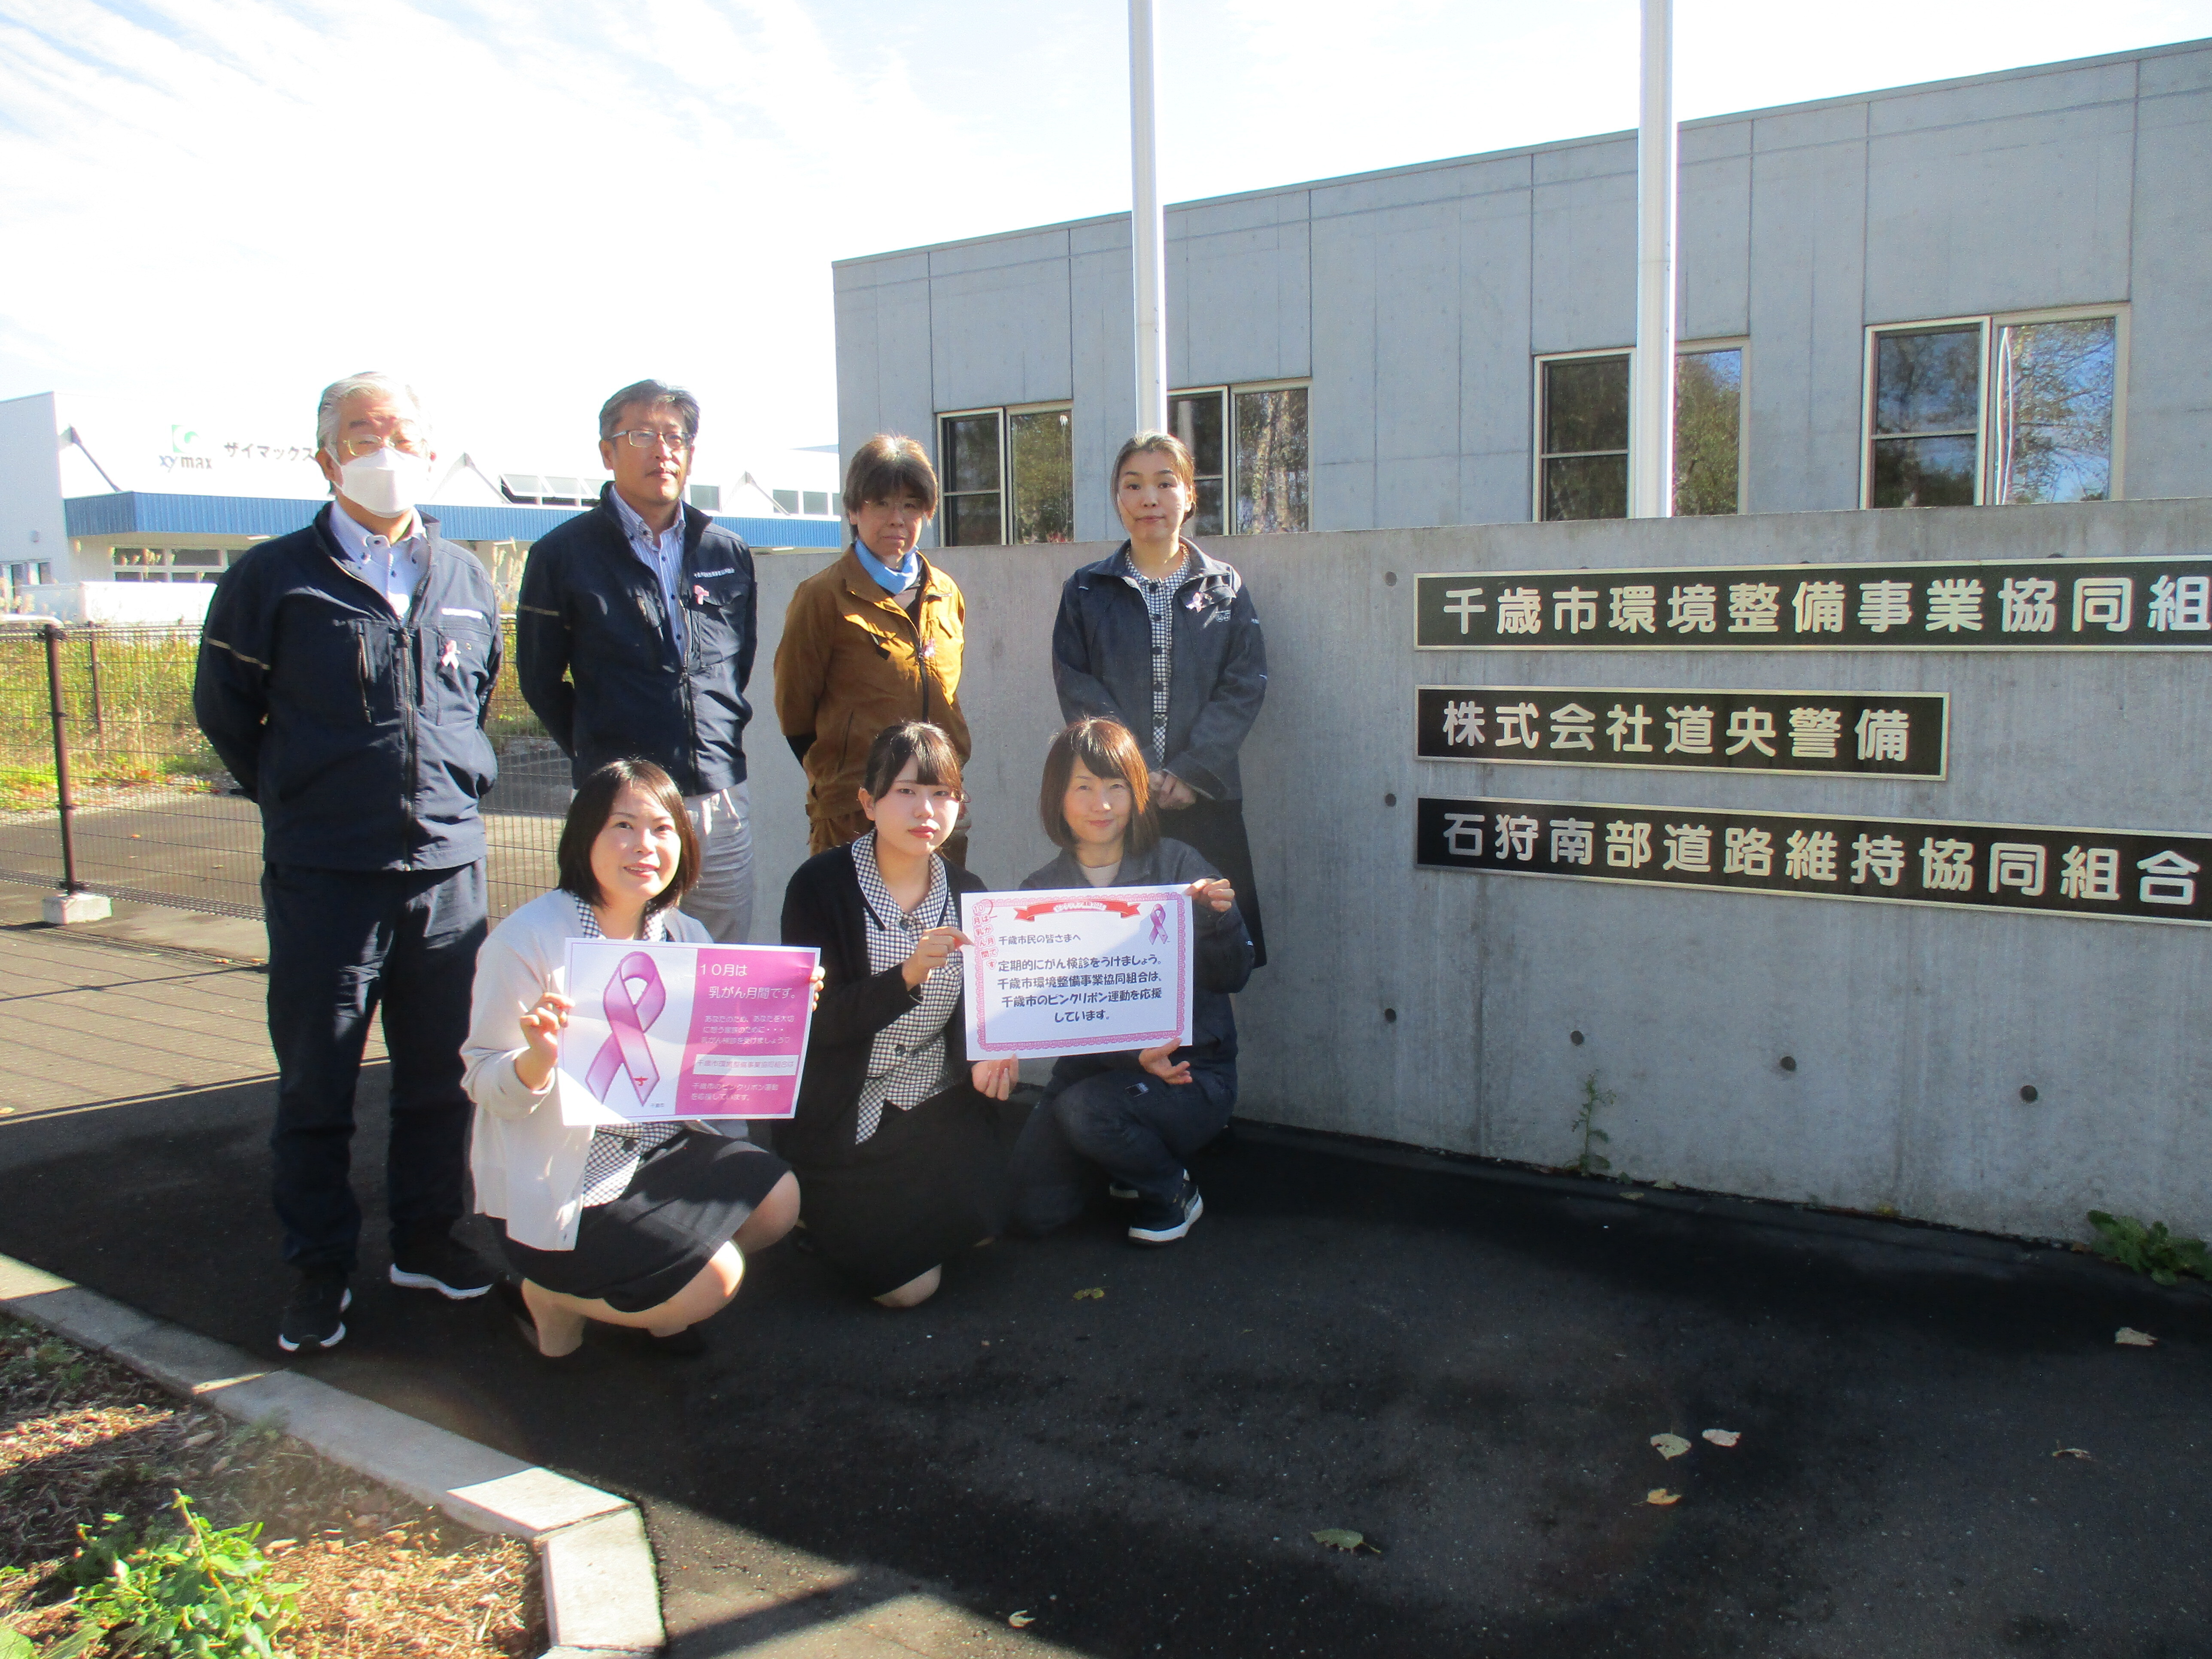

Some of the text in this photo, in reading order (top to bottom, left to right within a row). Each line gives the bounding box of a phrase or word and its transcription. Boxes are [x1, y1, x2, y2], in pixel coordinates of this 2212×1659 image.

[224, 442, 316, 461] ザイマックス
[158, 455, 213, 473] xymax
[1443, 574, 2212, 634] 千歳市環境整備事業協同組
[1443, 700, 1909, 761] 株式会社道央警備
[1443, 813, 2200, 905] 石狩南部道路維持協同組合
[999, 934, 1081, 945] 千歳市民の皆さまへ
[998, 954, 1161, 972] 定期的にがん検診をうけましょう。
[997, 971, 1162, 990] 千歳市環境整備事業協同組合は、
[708, 986, 795, 999] 乳がん月間です。
[1002, 988, 1162, 1008] 千歳市のピンクリボン運動を応援
[1054, 1009, 1110, 1023] しています。
